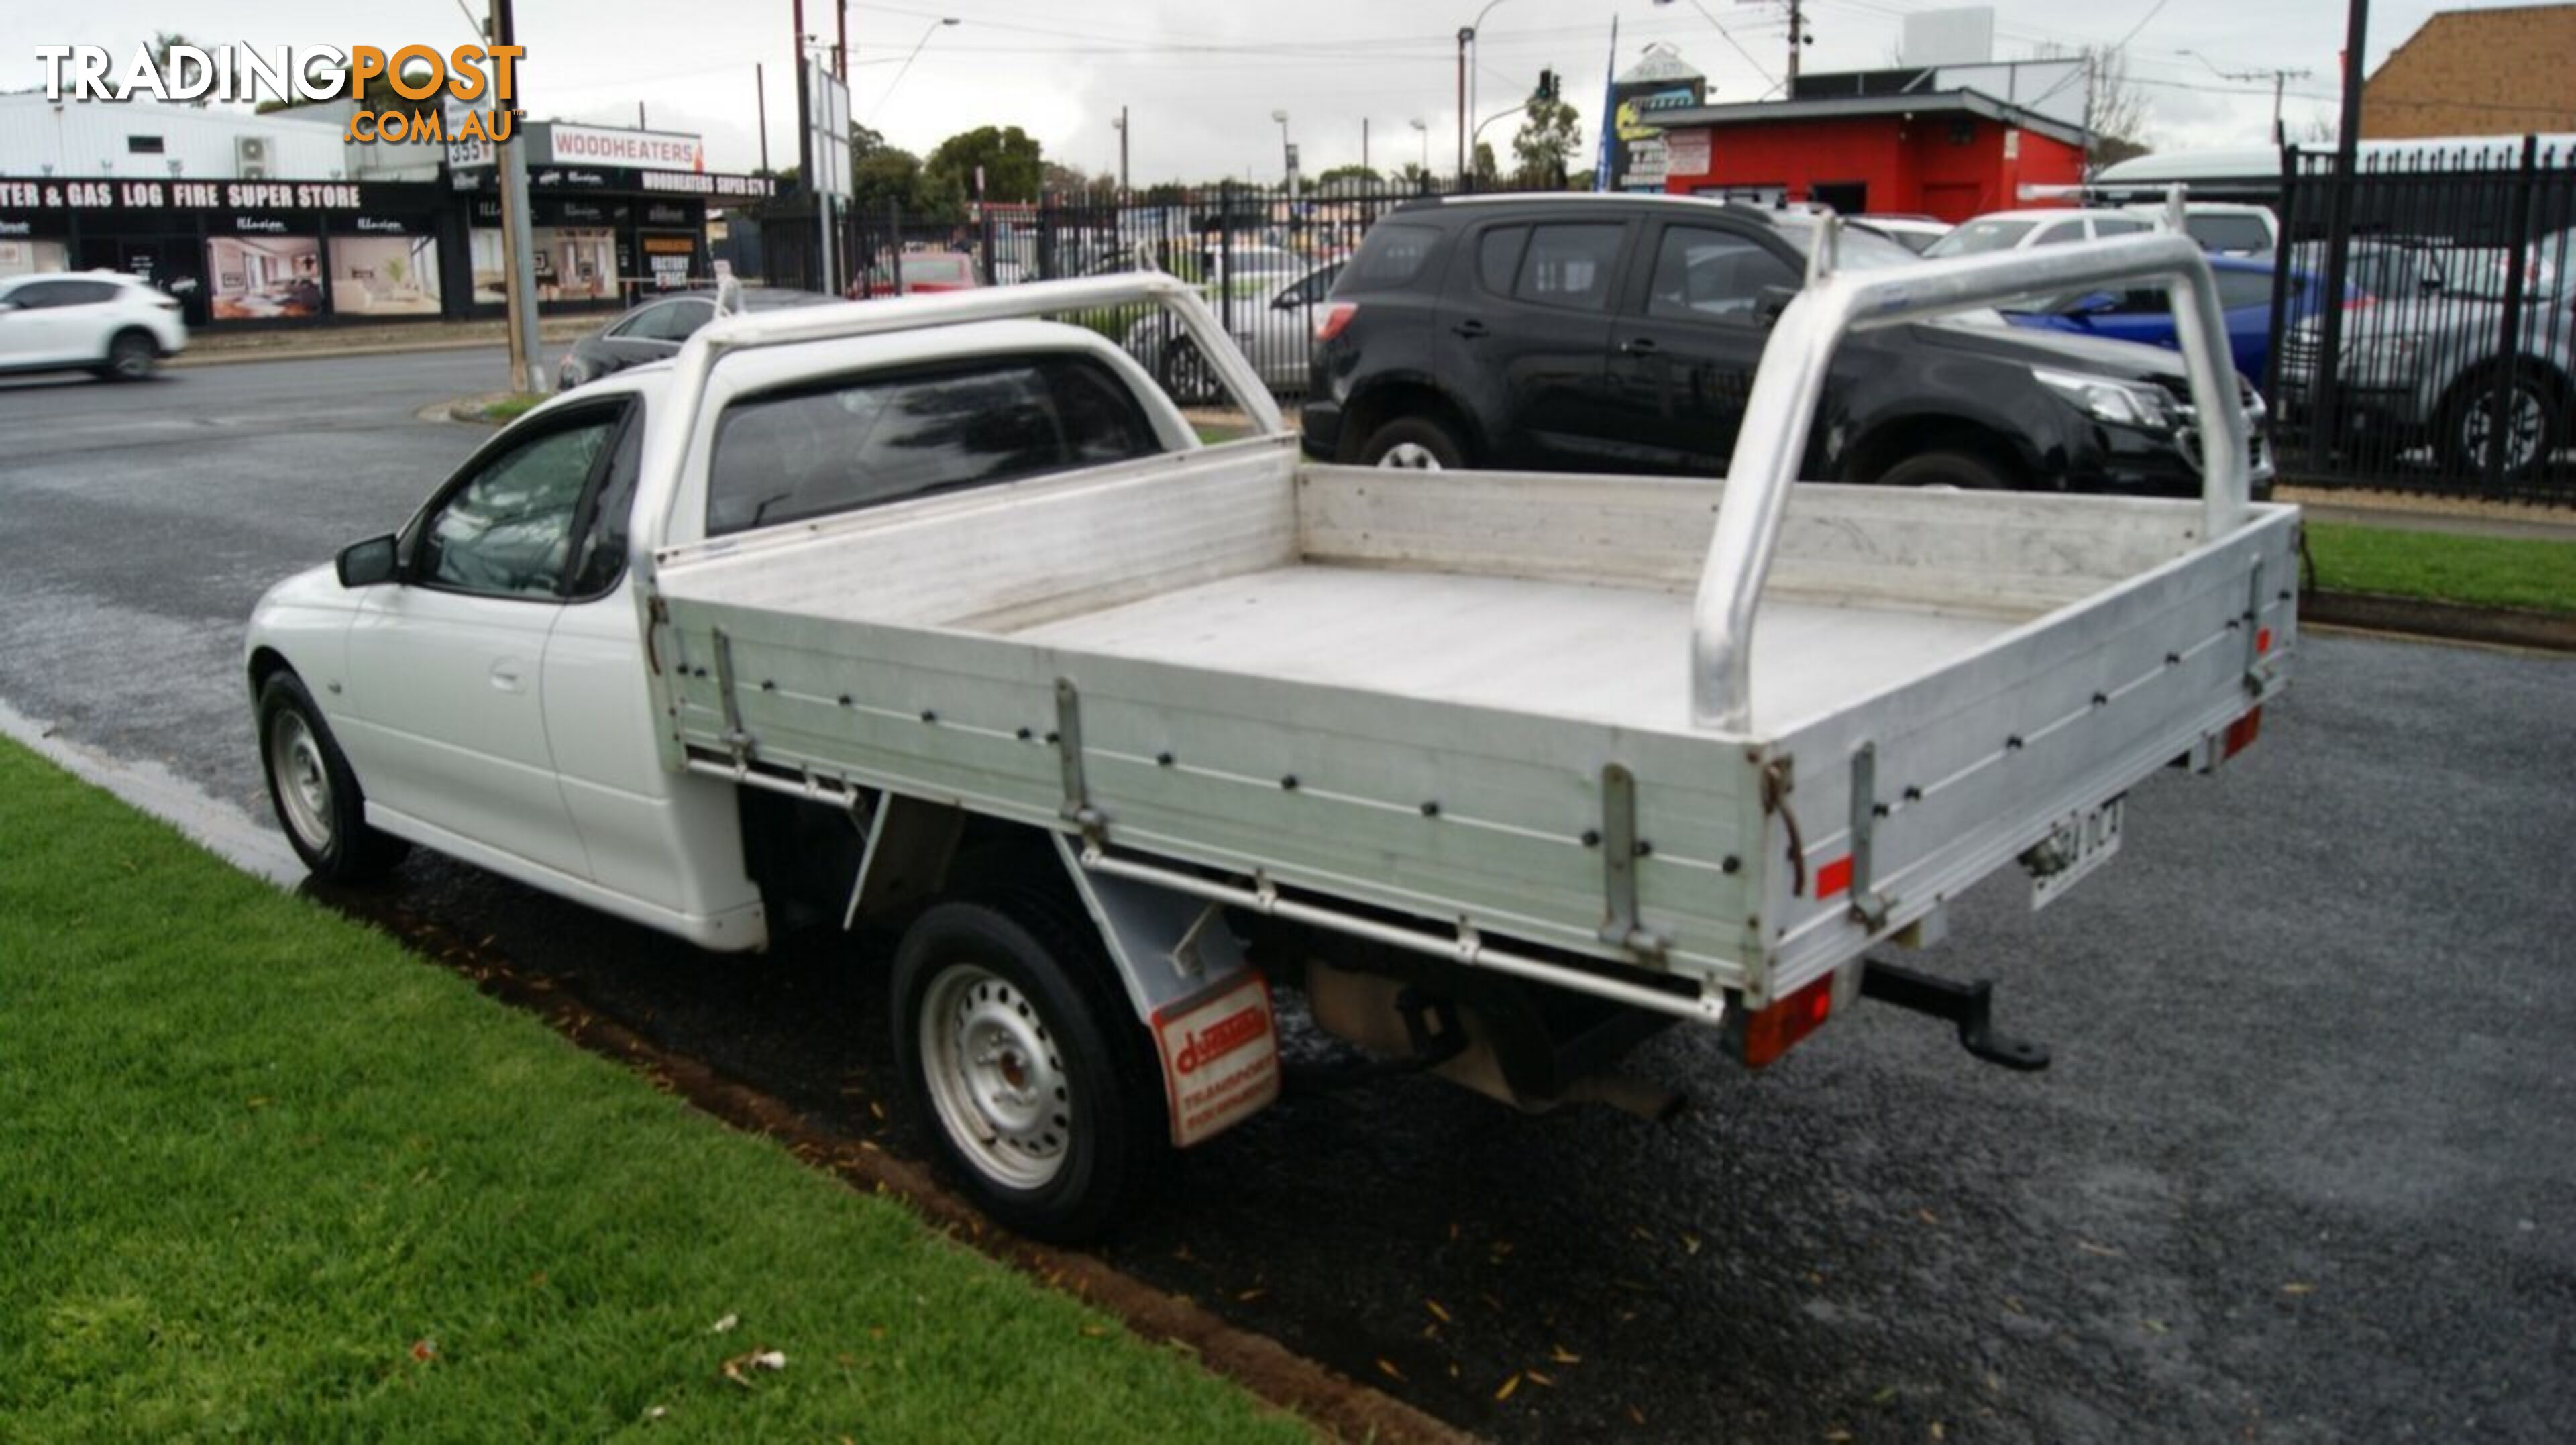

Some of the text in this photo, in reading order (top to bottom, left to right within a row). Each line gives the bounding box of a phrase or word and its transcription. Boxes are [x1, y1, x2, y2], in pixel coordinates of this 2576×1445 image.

[555, 133, 693, 162] WOODHEATERS
[46, 186, 63, 207] &
[66, 183, 113, 207] GAS
[121, 183, 164, 208] LOG
[174, 184, 219, 207] FIRE
[228, 184, 294, 208] SUPER
[298, 185, 360, 208] STORE
